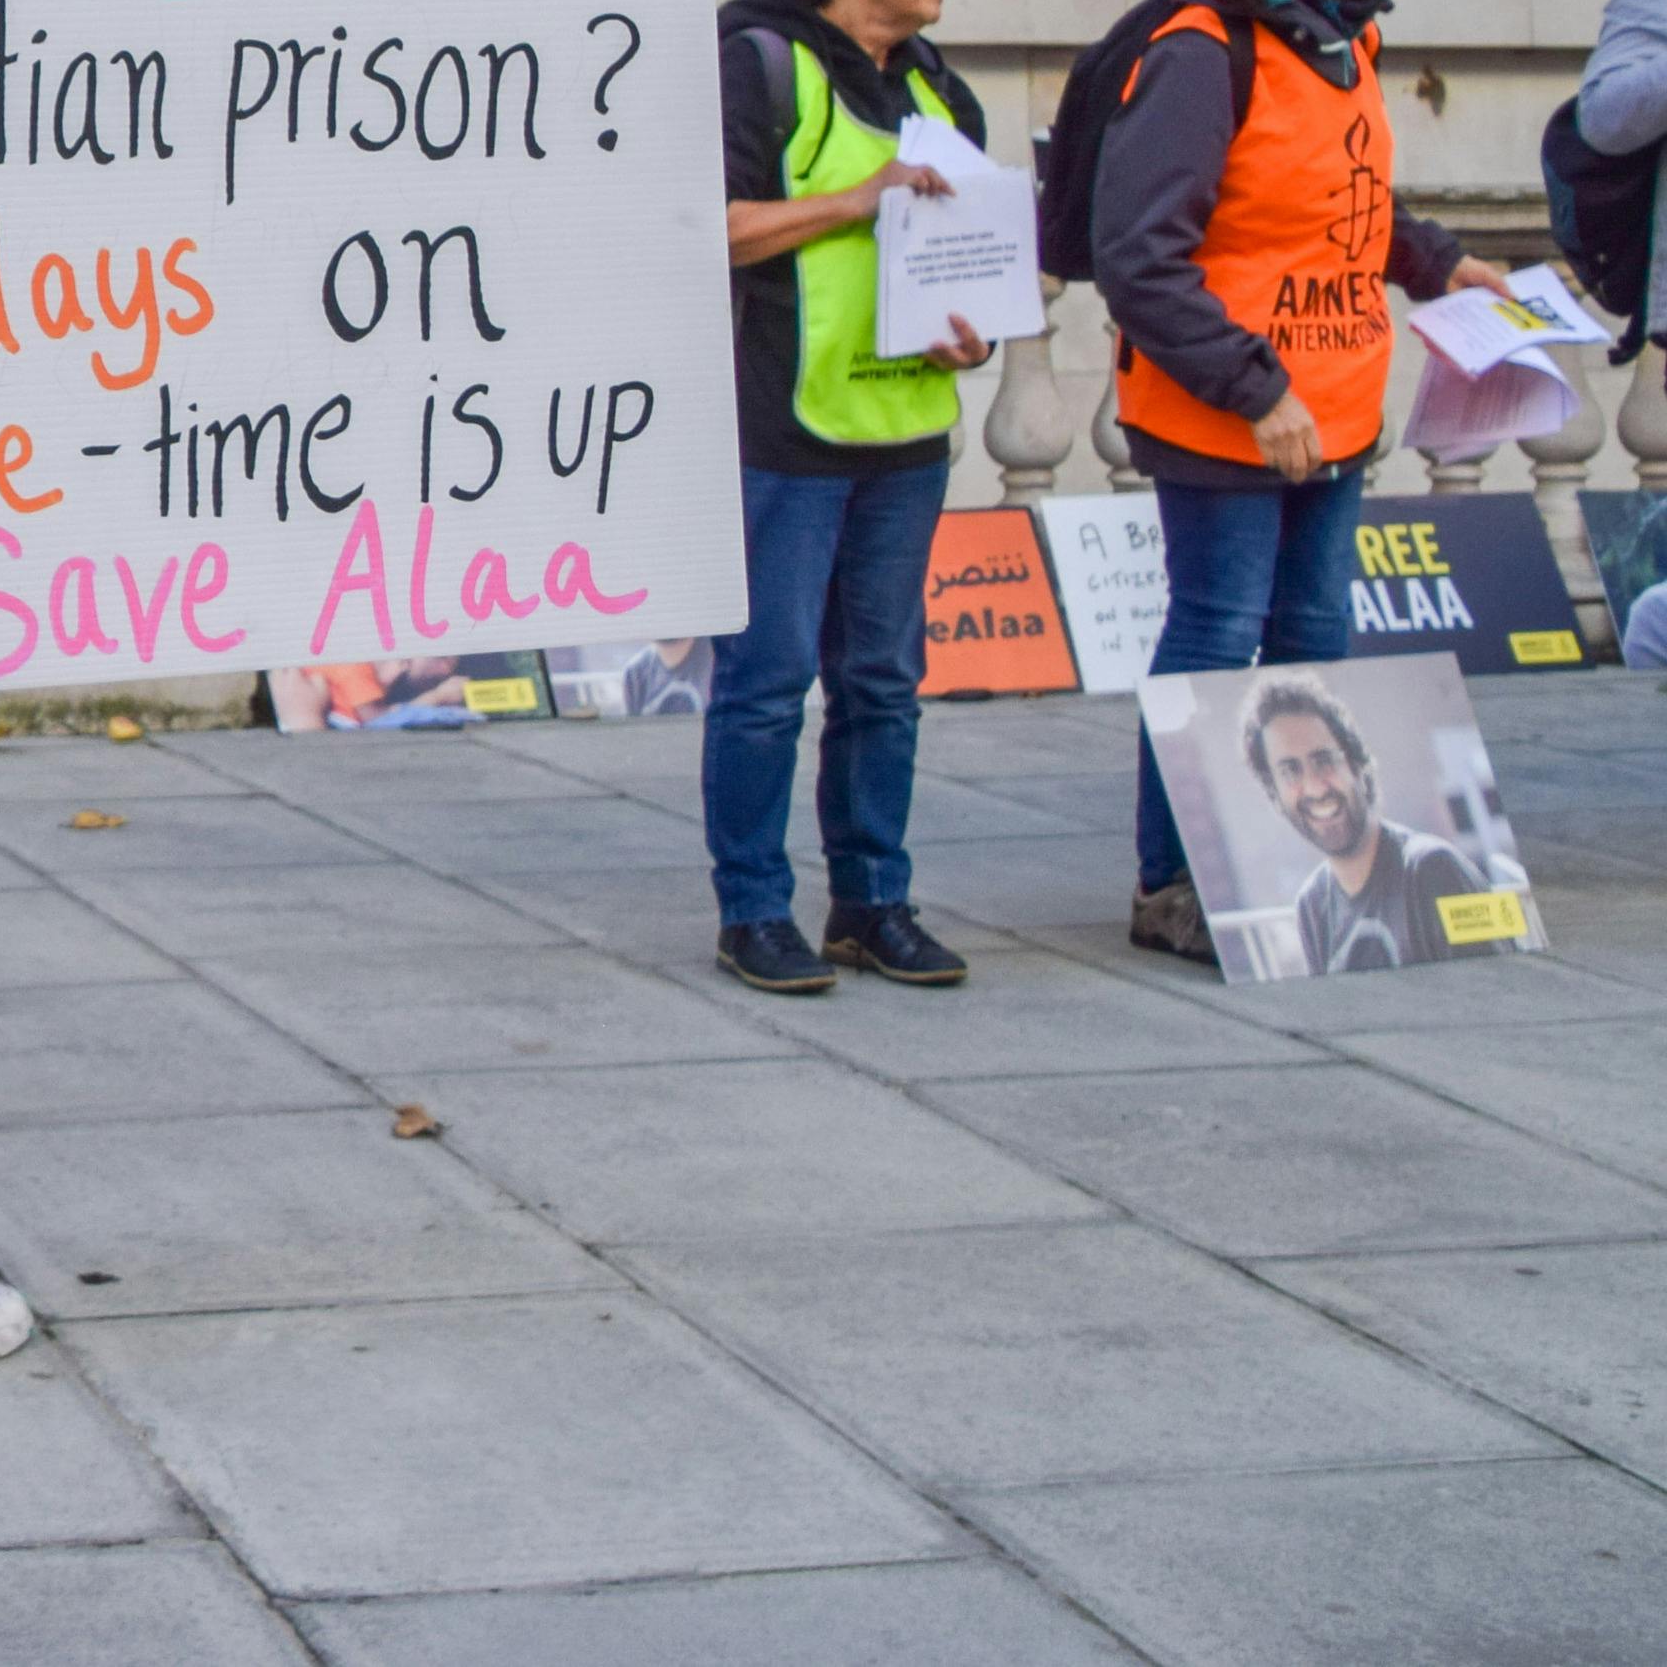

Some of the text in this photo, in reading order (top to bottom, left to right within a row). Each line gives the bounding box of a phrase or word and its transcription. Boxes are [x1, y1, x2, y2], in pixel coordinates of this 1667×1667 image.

[322, 226, 506, 343] on
[420, 375, 503, 504] is
[548, 381, 654, 515] up
[310, 498, 649, 657] Alaa
[1078, 522, 1107, 561] A
[1350, 576, 1474, 633] ALAA
